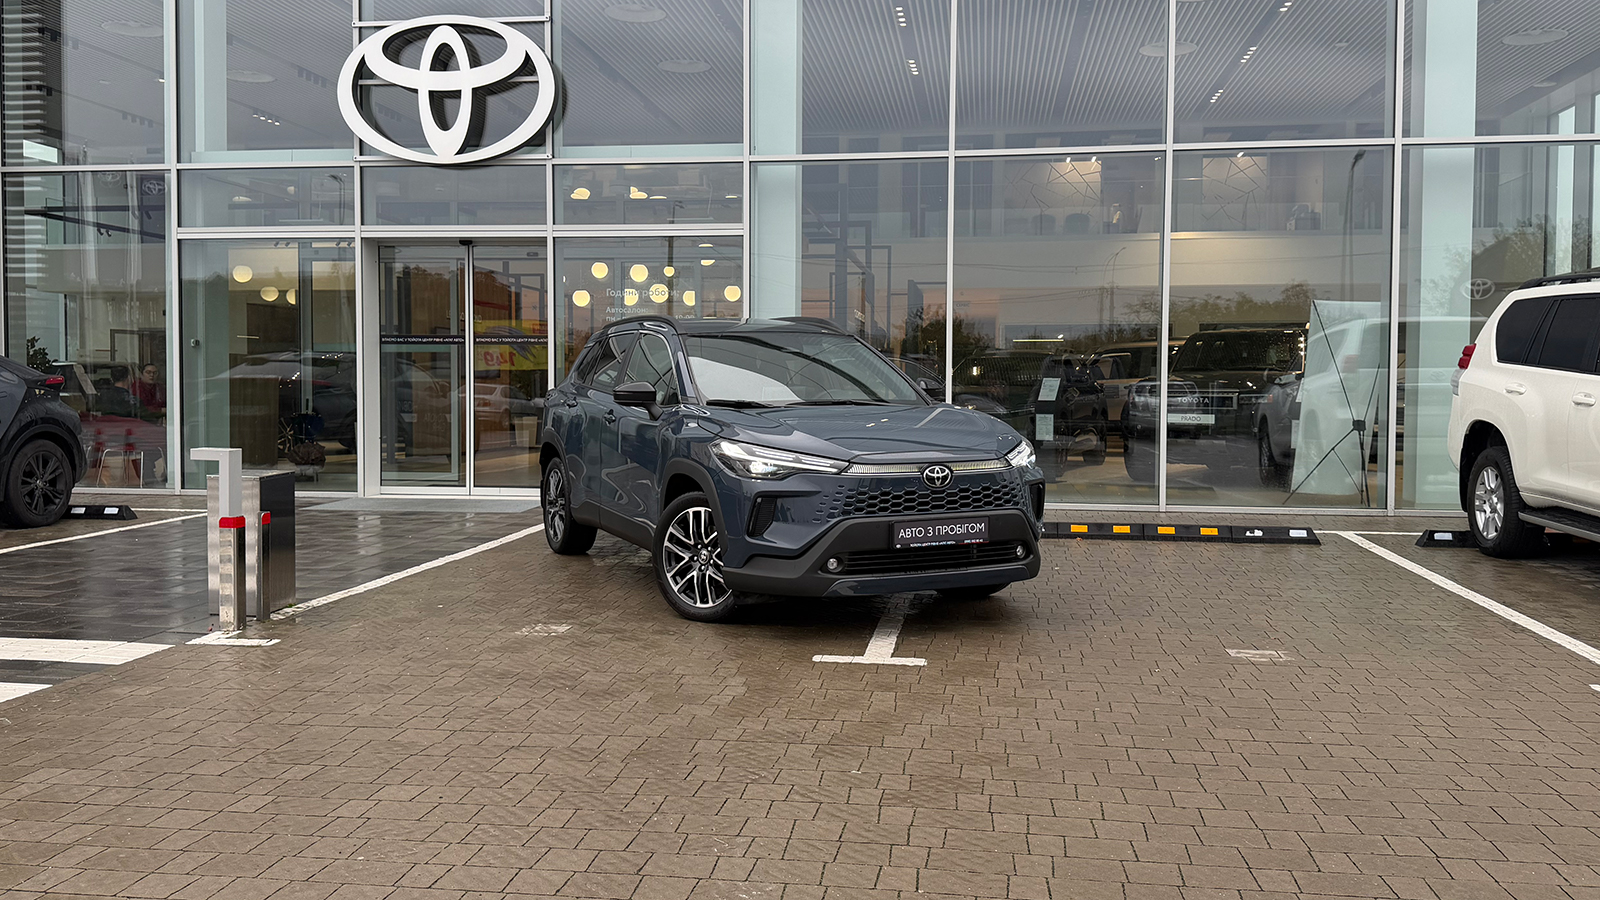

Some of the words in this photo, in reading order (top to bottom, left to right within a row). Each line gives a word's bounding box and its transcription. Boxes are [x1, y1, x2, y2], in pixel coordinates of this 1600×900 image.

[605, 306, 648, 314] Автосалон:
[898, 527, 925, 539] АВТО
[935, 522, 985, 536] ПРОБІГОМ
